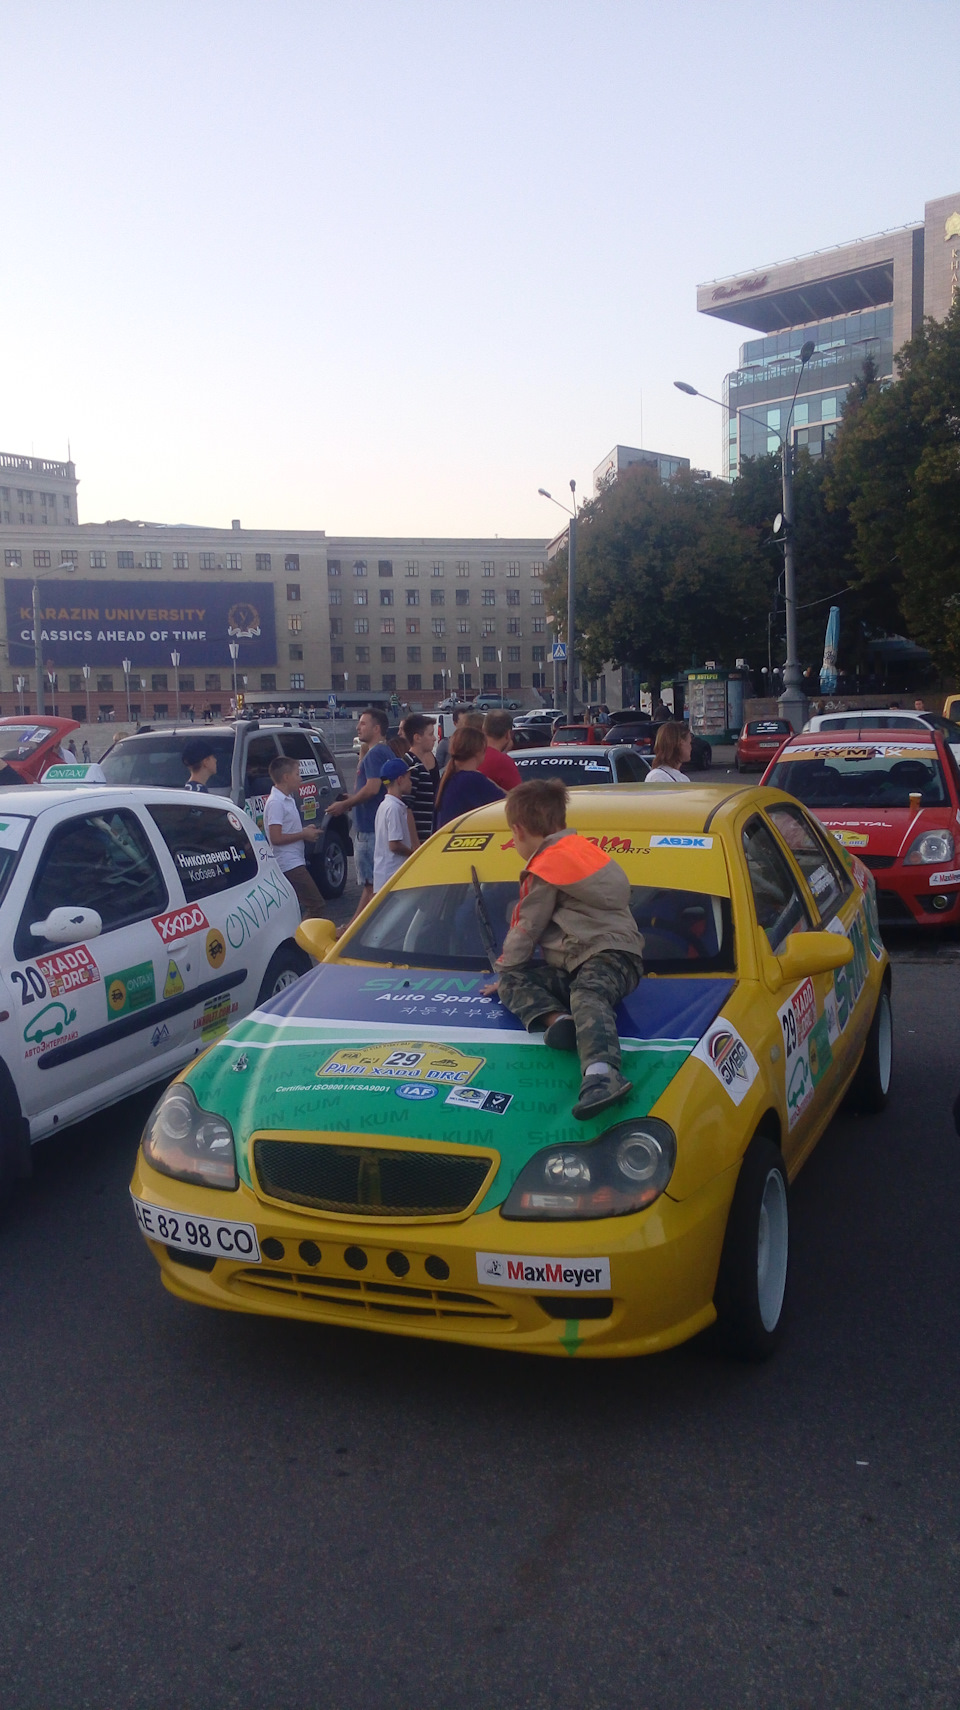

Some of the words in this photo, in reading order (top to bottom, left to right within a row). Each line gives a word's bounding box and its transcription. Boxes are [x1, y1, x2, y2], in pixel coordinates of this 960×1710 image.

[20, 607, 100, 620] KRAZIN
[105, 608, 206, 620] UNIVERSITY
[96, 630, 146, 642] AHEAD
[150, 631, 169, 642] OF
[172, 631, 207, 642] TIME
[814, 749, 903, 758] RYMAX
[49, 769, 84, 778] ONTAXI
[450, 837, 487, 848] OMP
[177, 850, 231, 868] Николаенко
[189, 868, 216, 882] Кобзев
[158, 908, 205, 939] XADO
[43, 949, 90, 976] XADO
[62, 968, 89, 989] DRC
[358, 978, 480, 992] SHIN
[11, 966, 47, 1006] 20
[375, 993, 426, 1001] Auto
[431, 993, 493, 1004] Spare
[782, 1008, 797, 1058] 29
[385, 1052, 420, 1066] 29
[426, 1070, 469, 1081] DRC
[275, 1084, 312, 1093] Certified
[311, 1084, 391, 1093] ISO9001/KSA9001
[518, 1078, 574, 1089] SHIN
[402, 1086, 432, 1096] IAF
[360, 1108, 410, 1129] KUM
[527, 1127, 585, 1145] SHIN
[135, 1203, 155, 1233] AE
[157, 1214, 182, 1242] 82
[185, 1221, 212, 1248] 98
[217, 1227, 253, 1254] CO
[507, 1260, 602, 1287] MaxMeyer
